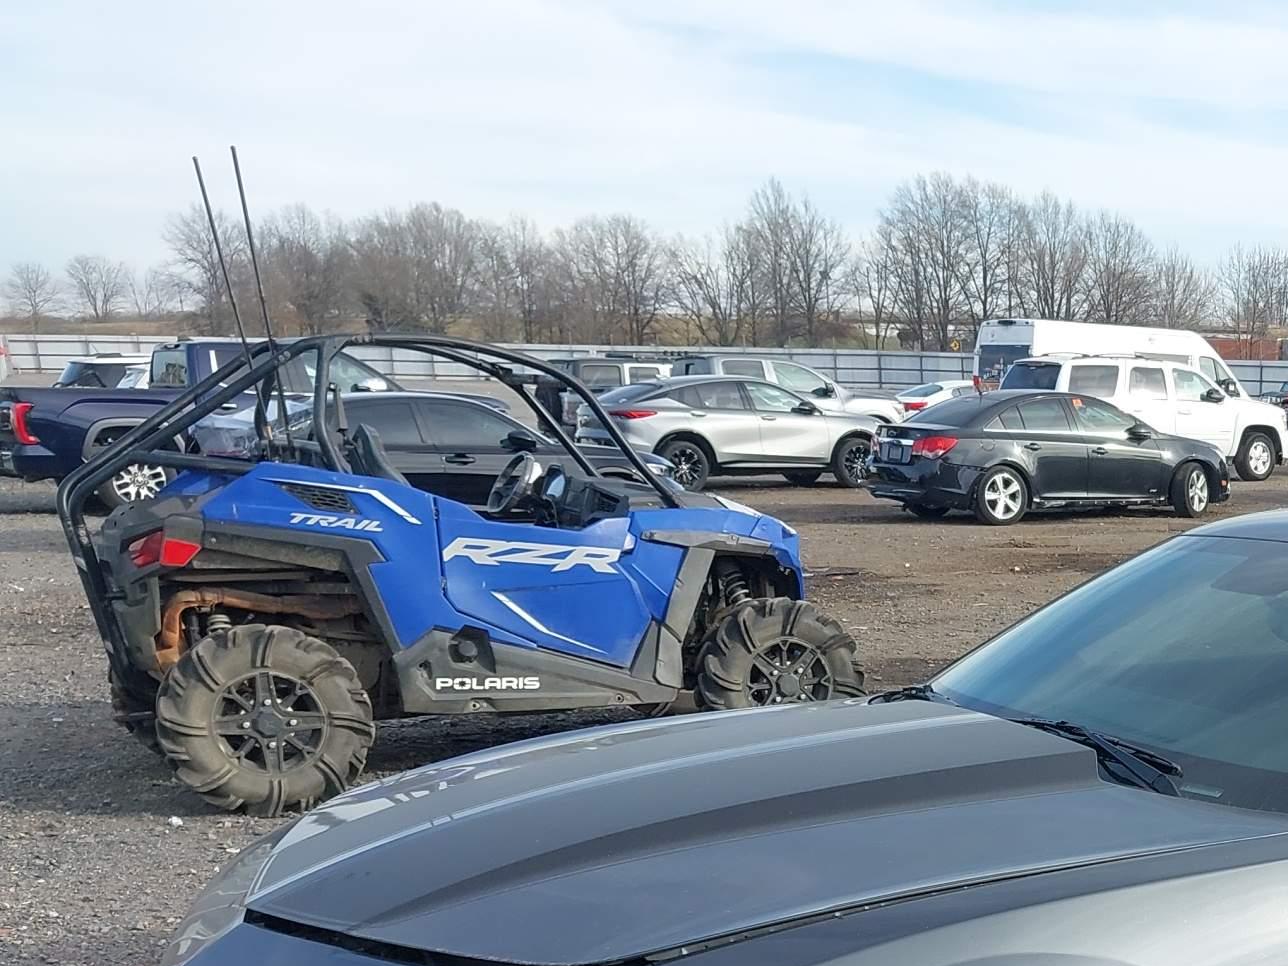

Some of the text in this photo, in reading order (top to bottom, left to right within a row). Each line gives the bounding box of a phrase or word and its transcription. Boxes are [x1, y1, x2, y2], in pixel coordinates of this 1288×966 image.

[289, 512, 384, 533] TRAIL
[442, 536, 622, 575] RZR
[435, 676, 541, 690] POLARIS
